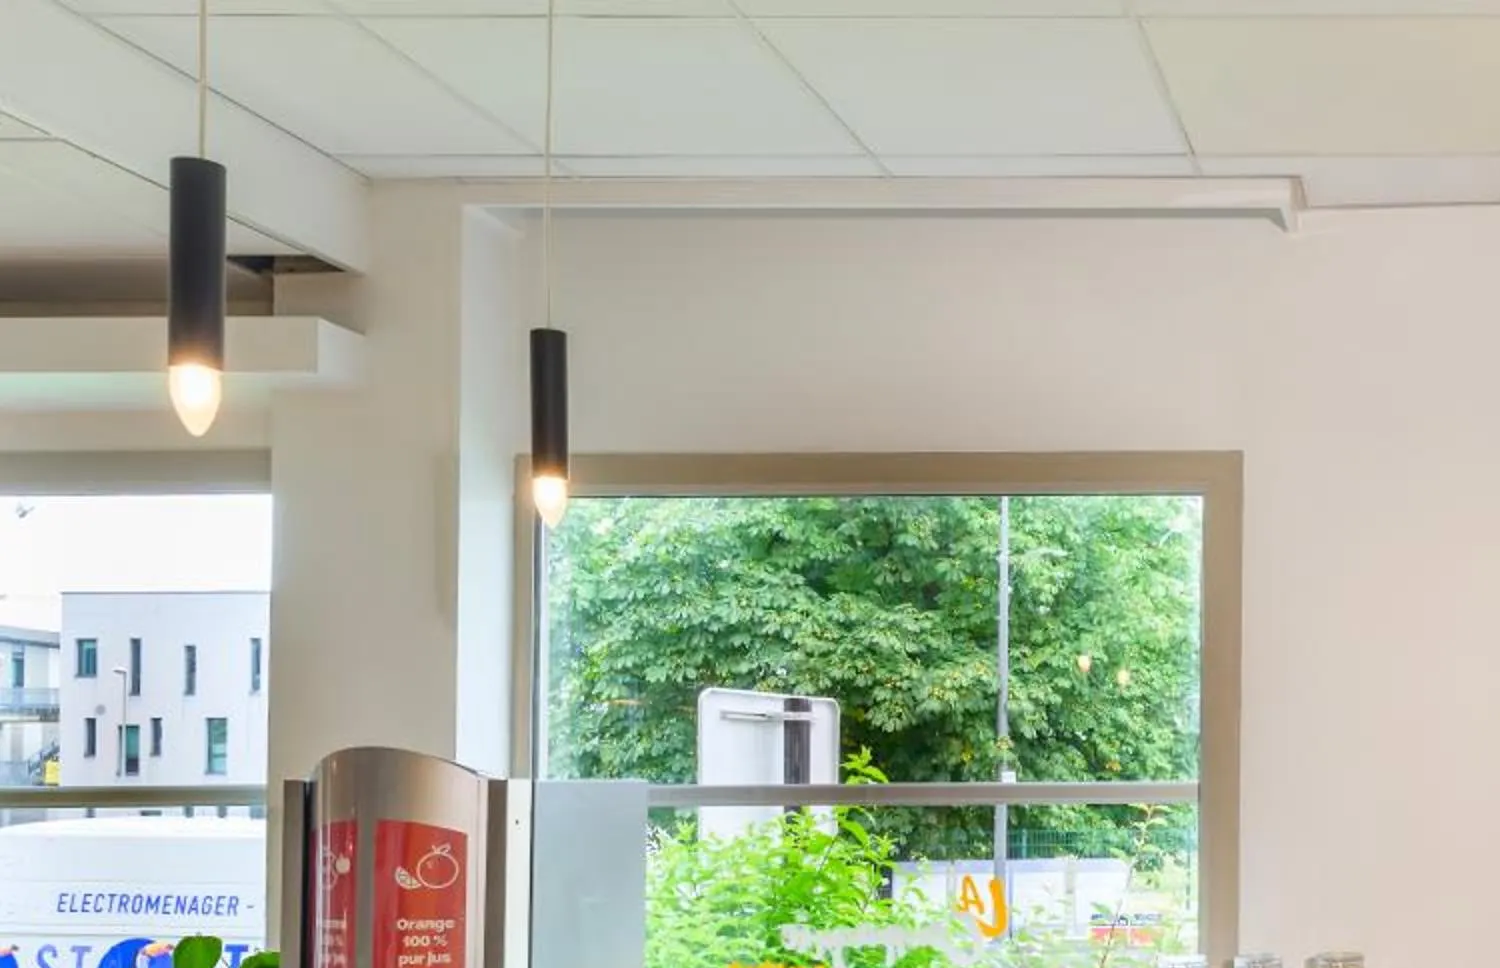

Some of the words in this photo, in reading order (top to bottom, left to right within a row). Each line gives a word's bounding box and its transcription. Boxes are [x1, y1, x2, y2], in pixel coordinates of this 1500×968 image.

[56, 893, 240, 916] ELECTROMENAGER
[396, 918, 455, 932] Orange
[402, 935, 431, 947] 100
[397, 954, 425, 968] pur
[426, 951, 452, 967] jus
